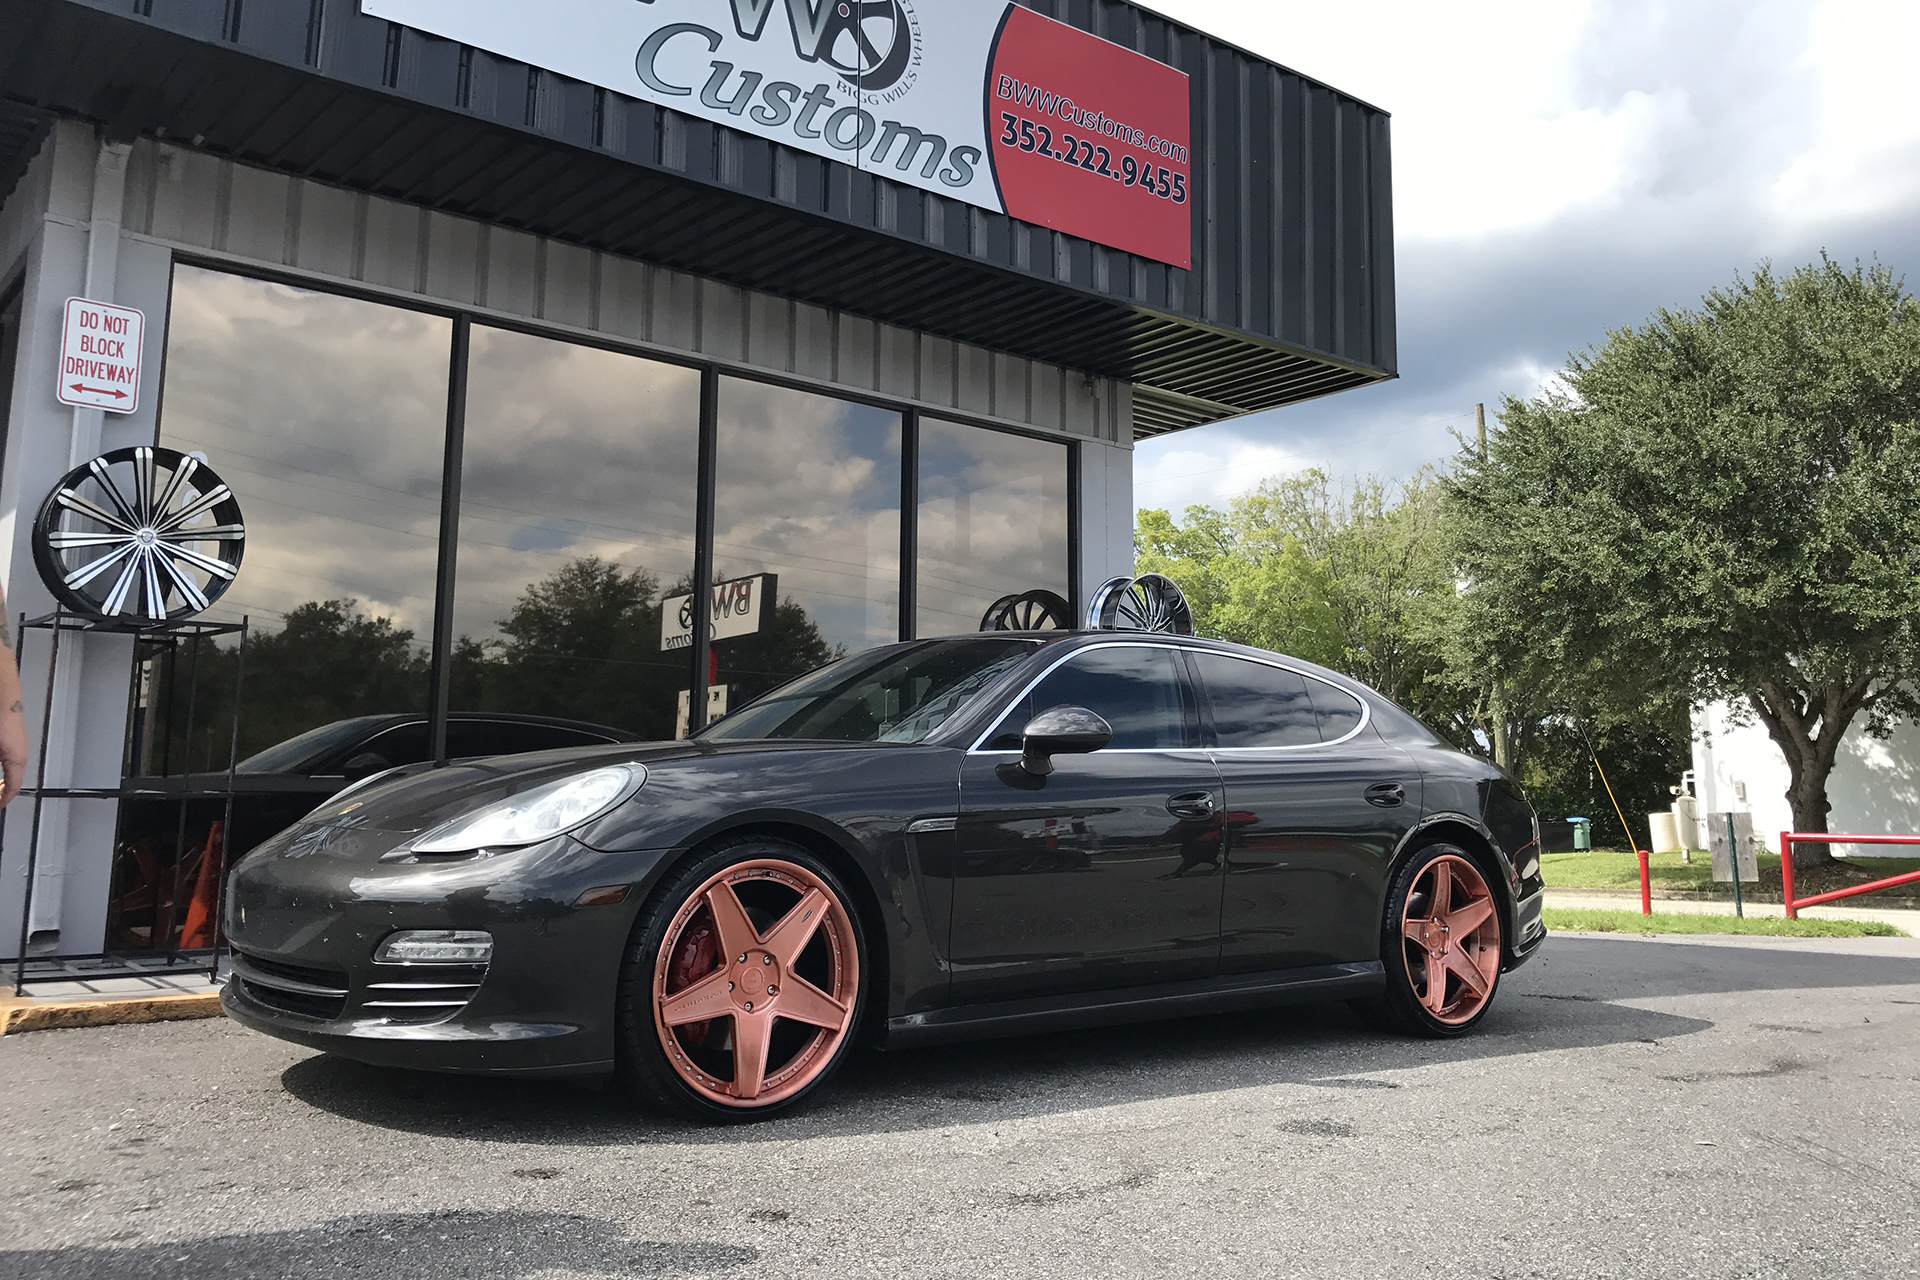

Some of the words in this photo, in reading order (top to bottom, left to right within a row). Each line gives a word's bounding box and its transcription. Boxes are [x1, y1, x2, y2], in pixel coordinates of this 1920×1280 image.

[635, 22, 982, 188] Customs
[836, 79, 879, 105] BIGG
[882, 69, 917, 104] WILL'S
[997, 74, 1187, 164] BWWCustoms.com
[1001, 111, 1187, 204] 352.222.9455
[80, 310, 99, 329] DO
[103, 314, 130, 336] NOT
[80, 335, 124, 359] BLOCK
[66, 356, 135, 384] DRIVEWAY
